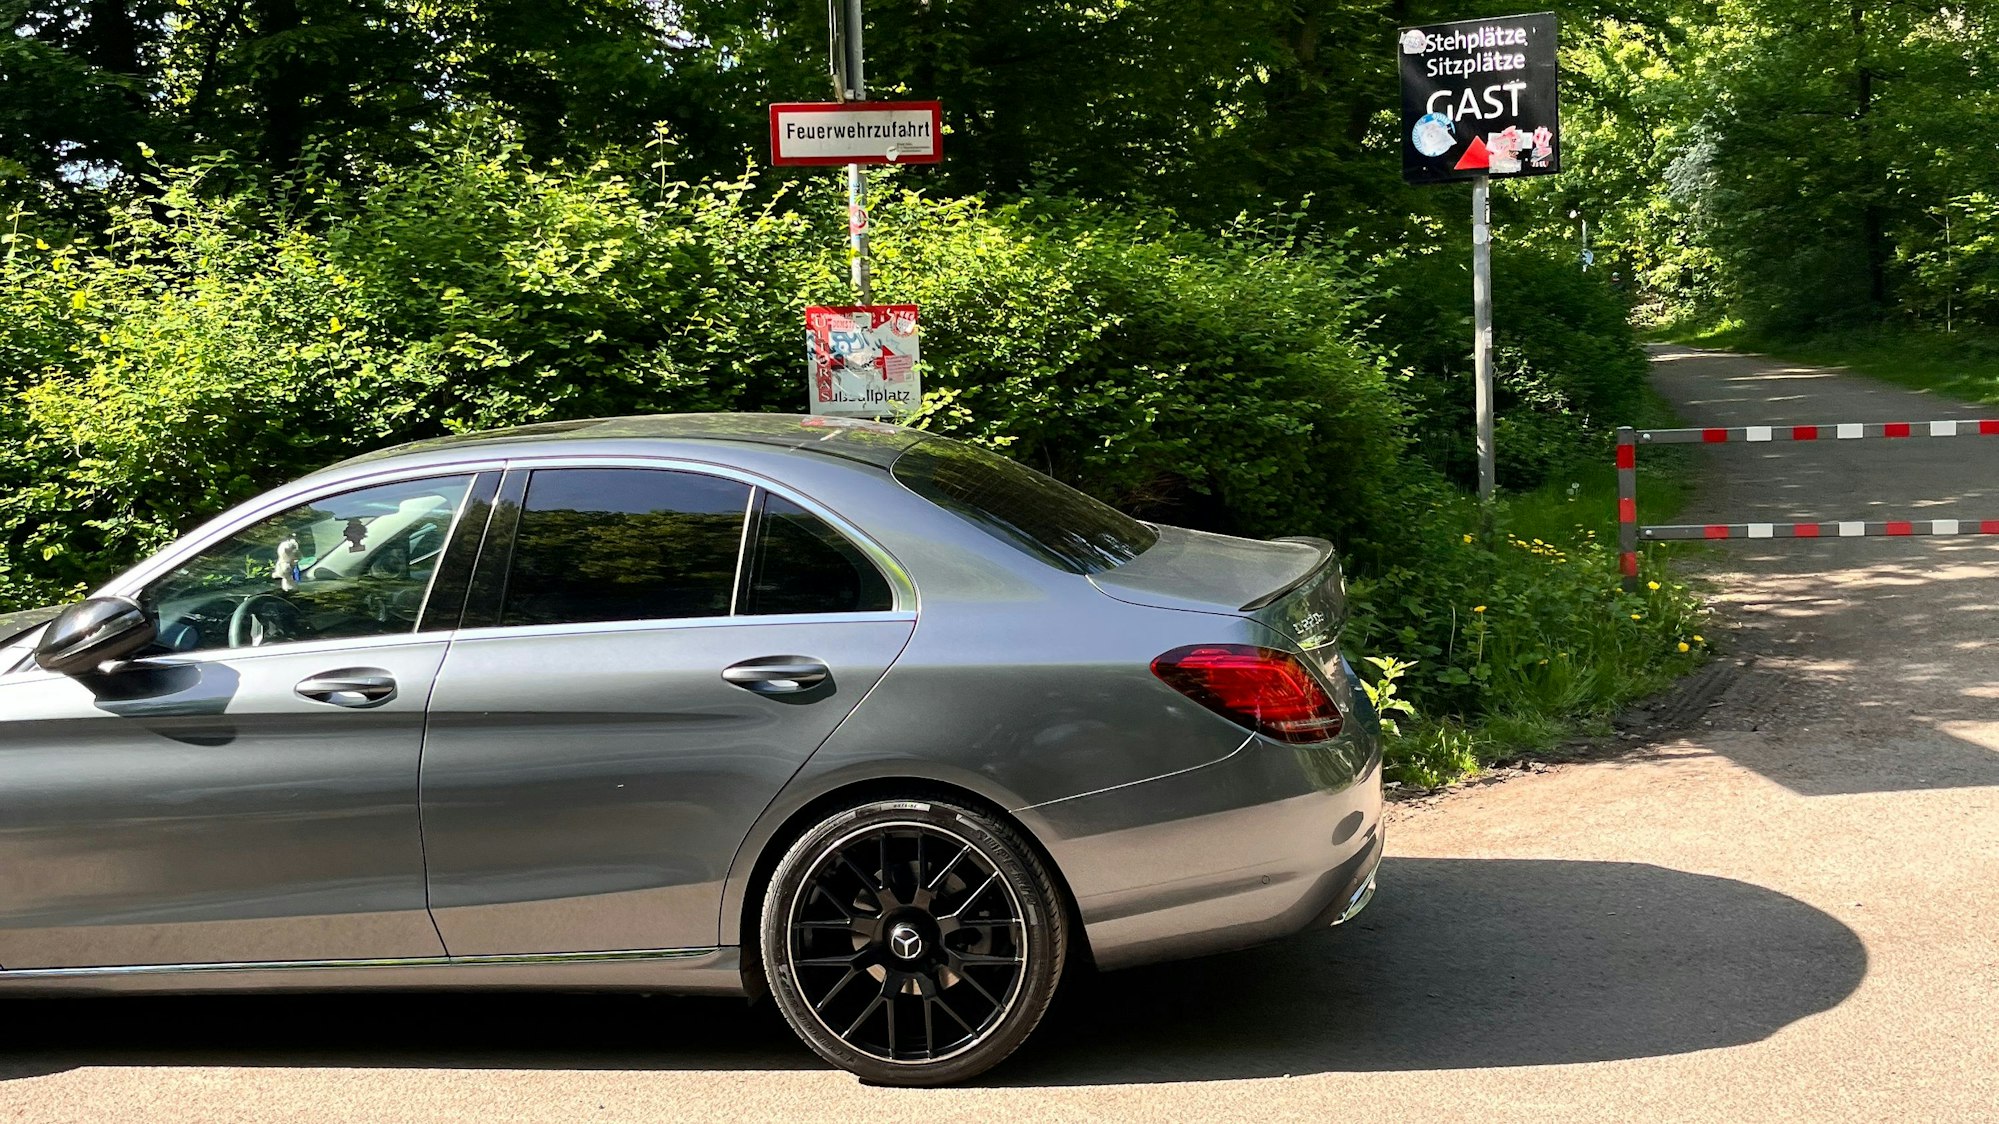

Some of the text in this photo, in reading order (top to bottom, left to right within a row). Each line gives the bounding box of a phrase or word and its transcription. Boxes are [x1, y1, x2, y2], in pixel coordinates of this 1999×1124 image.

[1425, 26, 1526, 54] Stehplätze
[1427, 52, 1525, 79] Sitzplätze
[1426, 82, 1527, 122] GAST
[786, 121, 930, 139] Feuerwehrzufahrt
